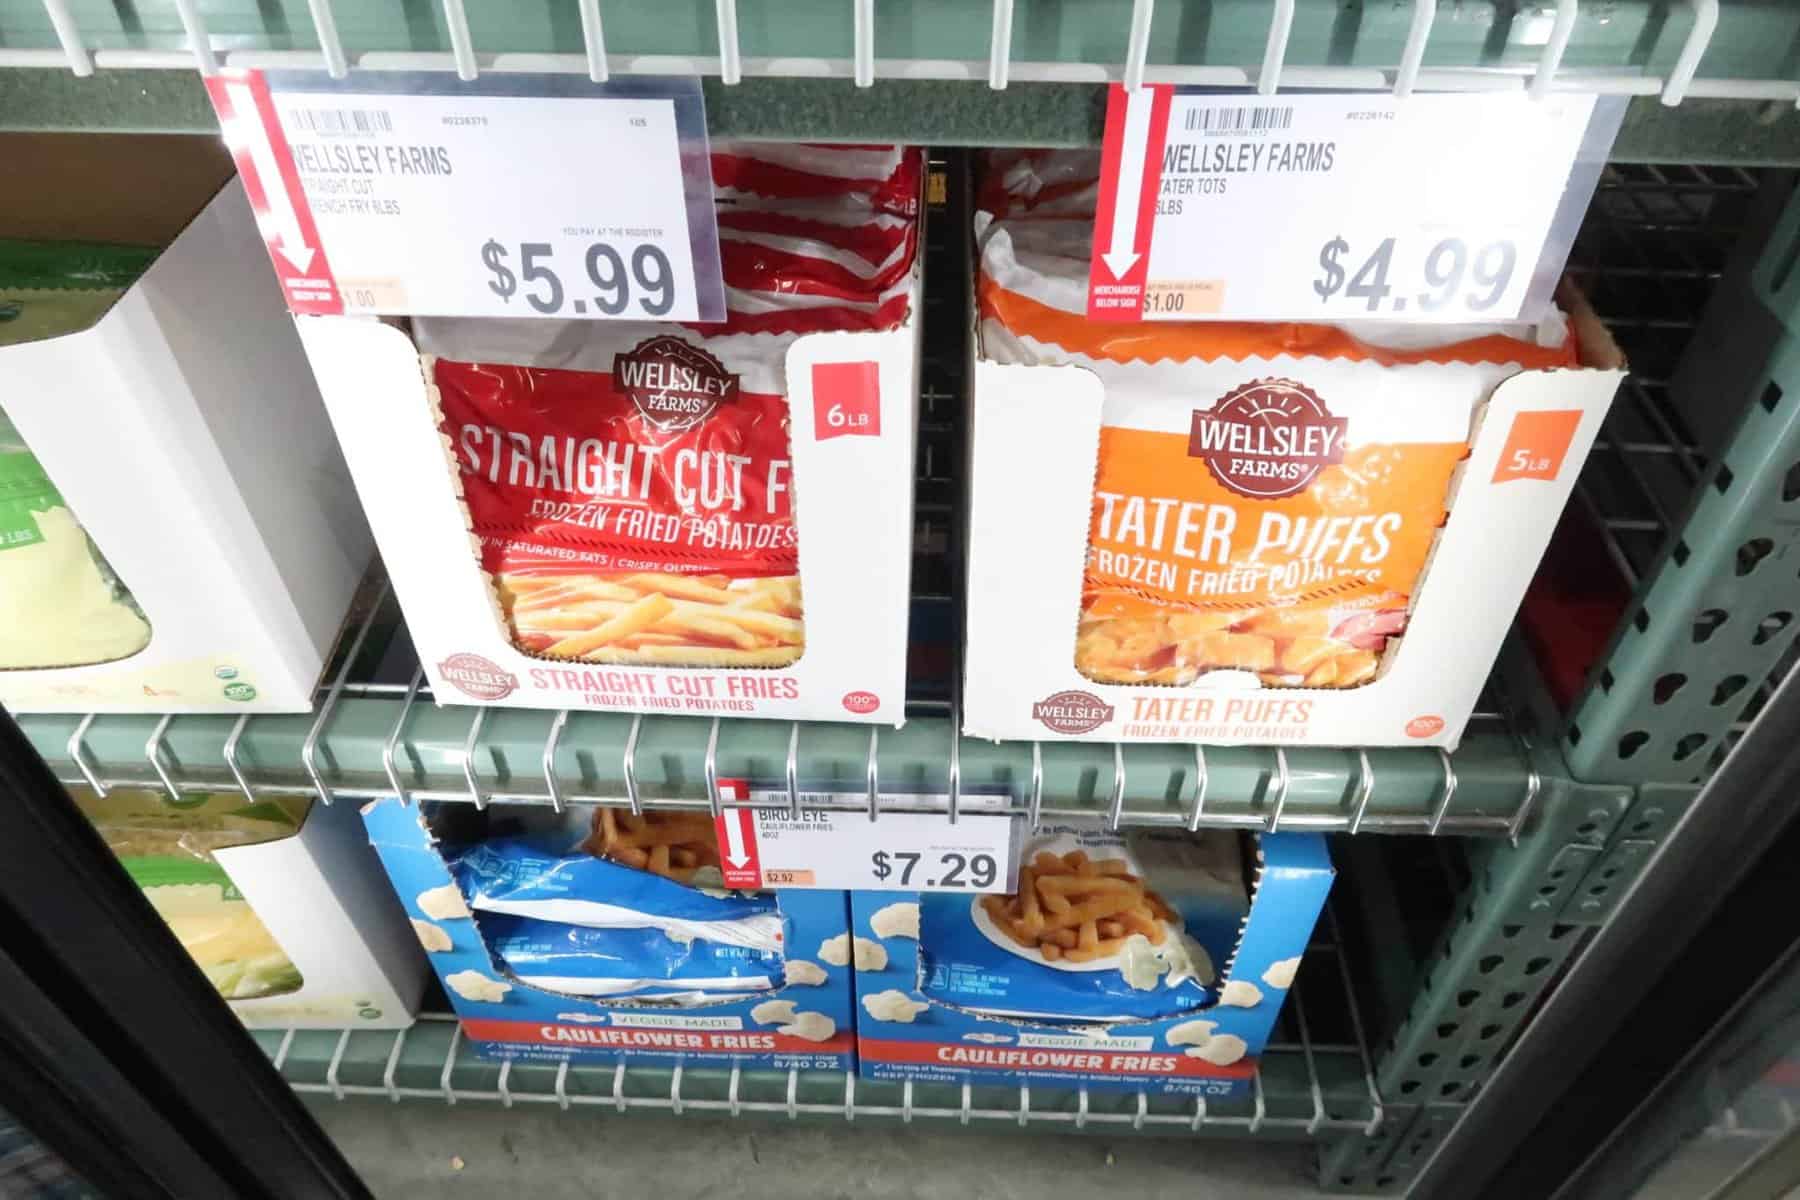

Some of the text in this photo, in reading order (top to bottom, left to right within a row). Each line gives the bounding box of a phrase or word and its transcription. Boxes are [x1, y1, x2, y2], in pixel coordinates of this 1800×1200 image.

[384, 146, 453, 175] FARMS
[1267, 142, 1336, 172] FARMS
[351, 178, 375, 195] CUT
[1198, 178, 1227, 194] TOTS
[580, 228, 595, 236] PAY
[608, 228, 623, 237] THE
[481, 238, 675, 316] $5.99
[1313, 234, 1517, 312] $4.99
[1143, 292, 1185, 313] $1.00
[621, 360, 732, 397] WELLSLEY
[1199, 418, 1338, 457] WELLSLEY
[461, 423, 664, 500] STRAIGHT
[674, 448, 752, 514] CUT
[529, 498, 796, 551] FROZEN FRIED POTATOES
[1096, 491, 1401, 566] TATER PUFFS
[505, 540, 575, 562] SATURATED
[579, 553, 607, 566] FATS
[1187, 567, 1258, 597] FRIED
[528, 668, 799, 700] STRAIGHT CUT FRIES
[584, 693, 755, 712] FROZEN FRIED POTATOES
[1037, 705, 1110, 720] WELLSLEY
[1130, 696, 1313, 724] TATER PUFFS
[1122, 723, 1181, 738] FROZEN
[760, 823, 833, 833] CAULIFLOWER FRIES
[802, 810, 829, 823] EYE
[872, 850, 997, 888] $7.29
[620, 1015, 681, 1027] VEGGIE
[684, 1016, 737, 1028] MADE
[540, 1026, 776, 1049] CAULIFLOWER FRIES
[1024, 1036, 1084, 1048] VEGGIE
[814, 1060, 841, 1069] OZ
[938, 1047, 1178, 1072] CAULIFLOWER FRIES
